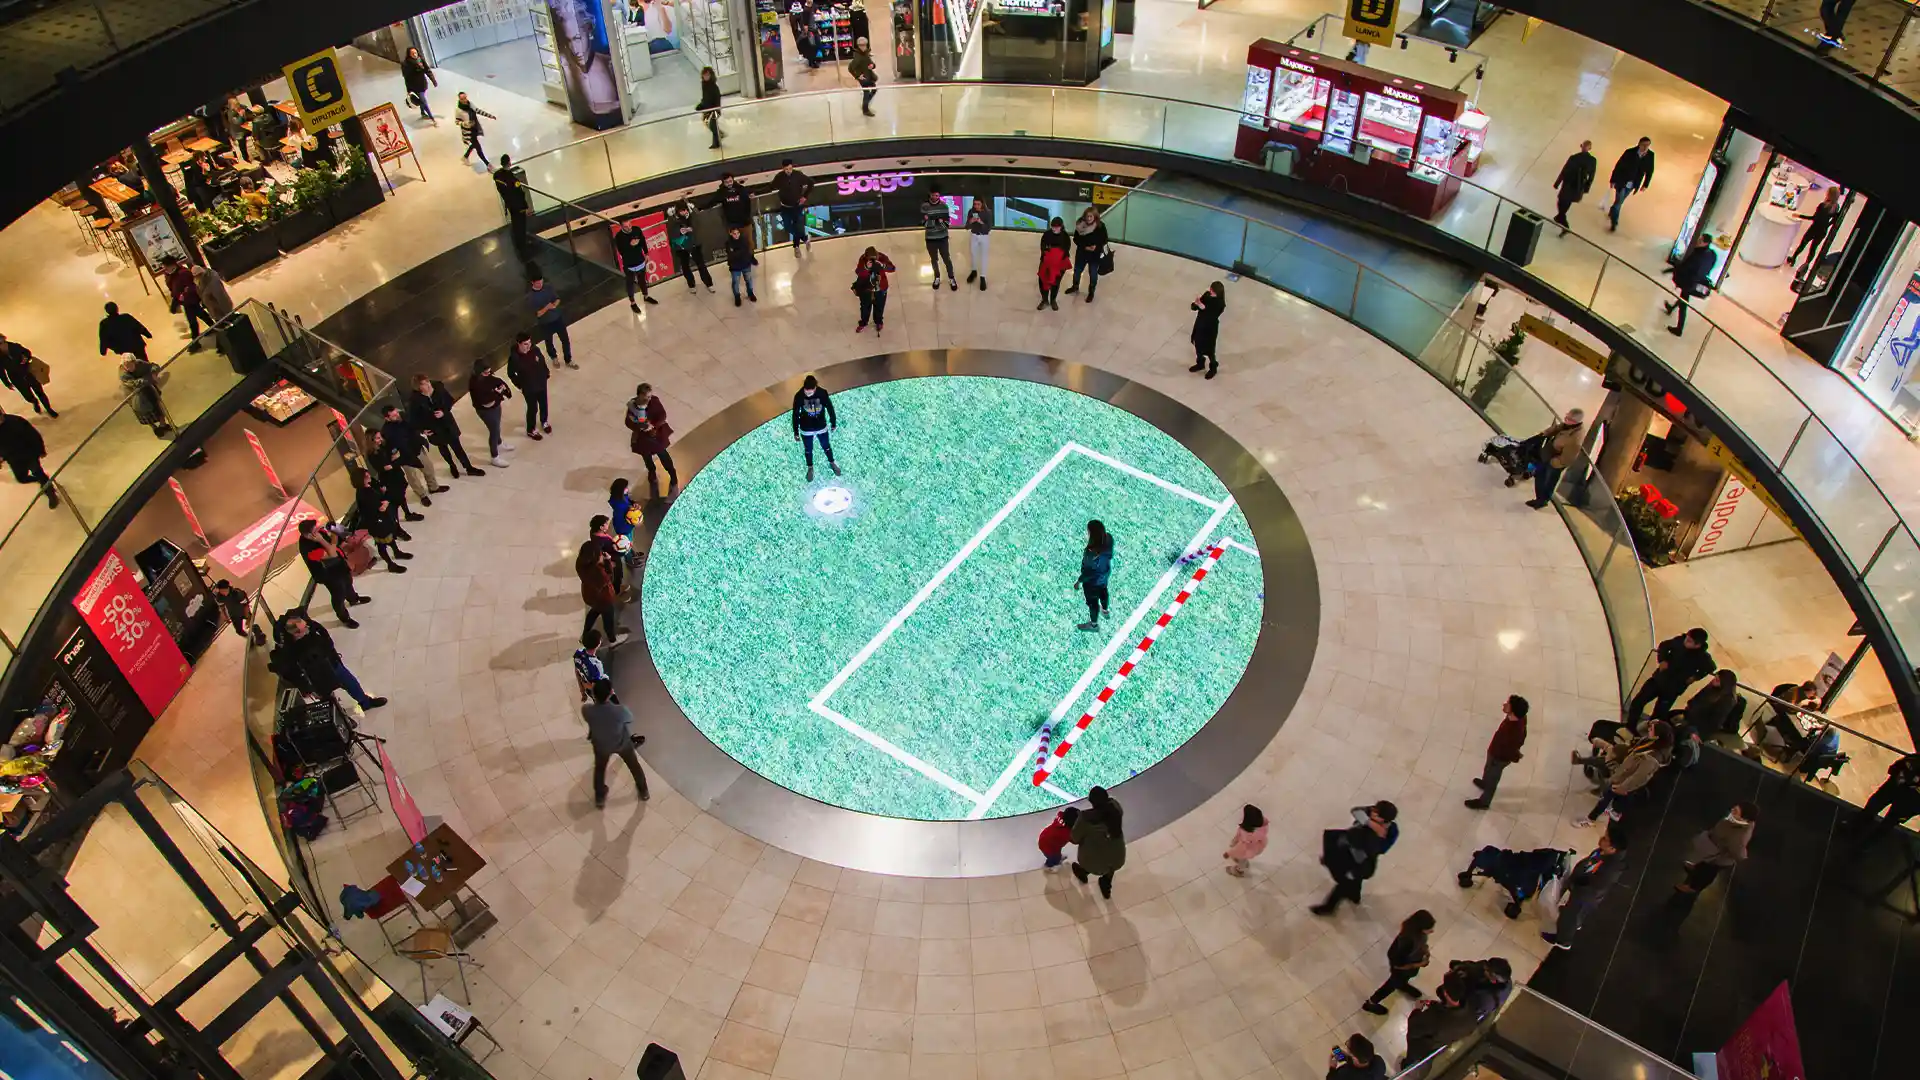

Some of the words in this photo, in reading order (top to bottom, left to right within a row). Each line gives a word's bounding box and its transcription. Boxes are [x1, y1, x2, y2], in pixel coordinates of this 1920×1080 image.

[837, 171, 914, 196] yoigo
[100, 590, 133, 626] -50%
[109, 605, 142, 640] -40%
[63, 638, 85, 665] fnac
[119, 619, 151, 652] -30%
